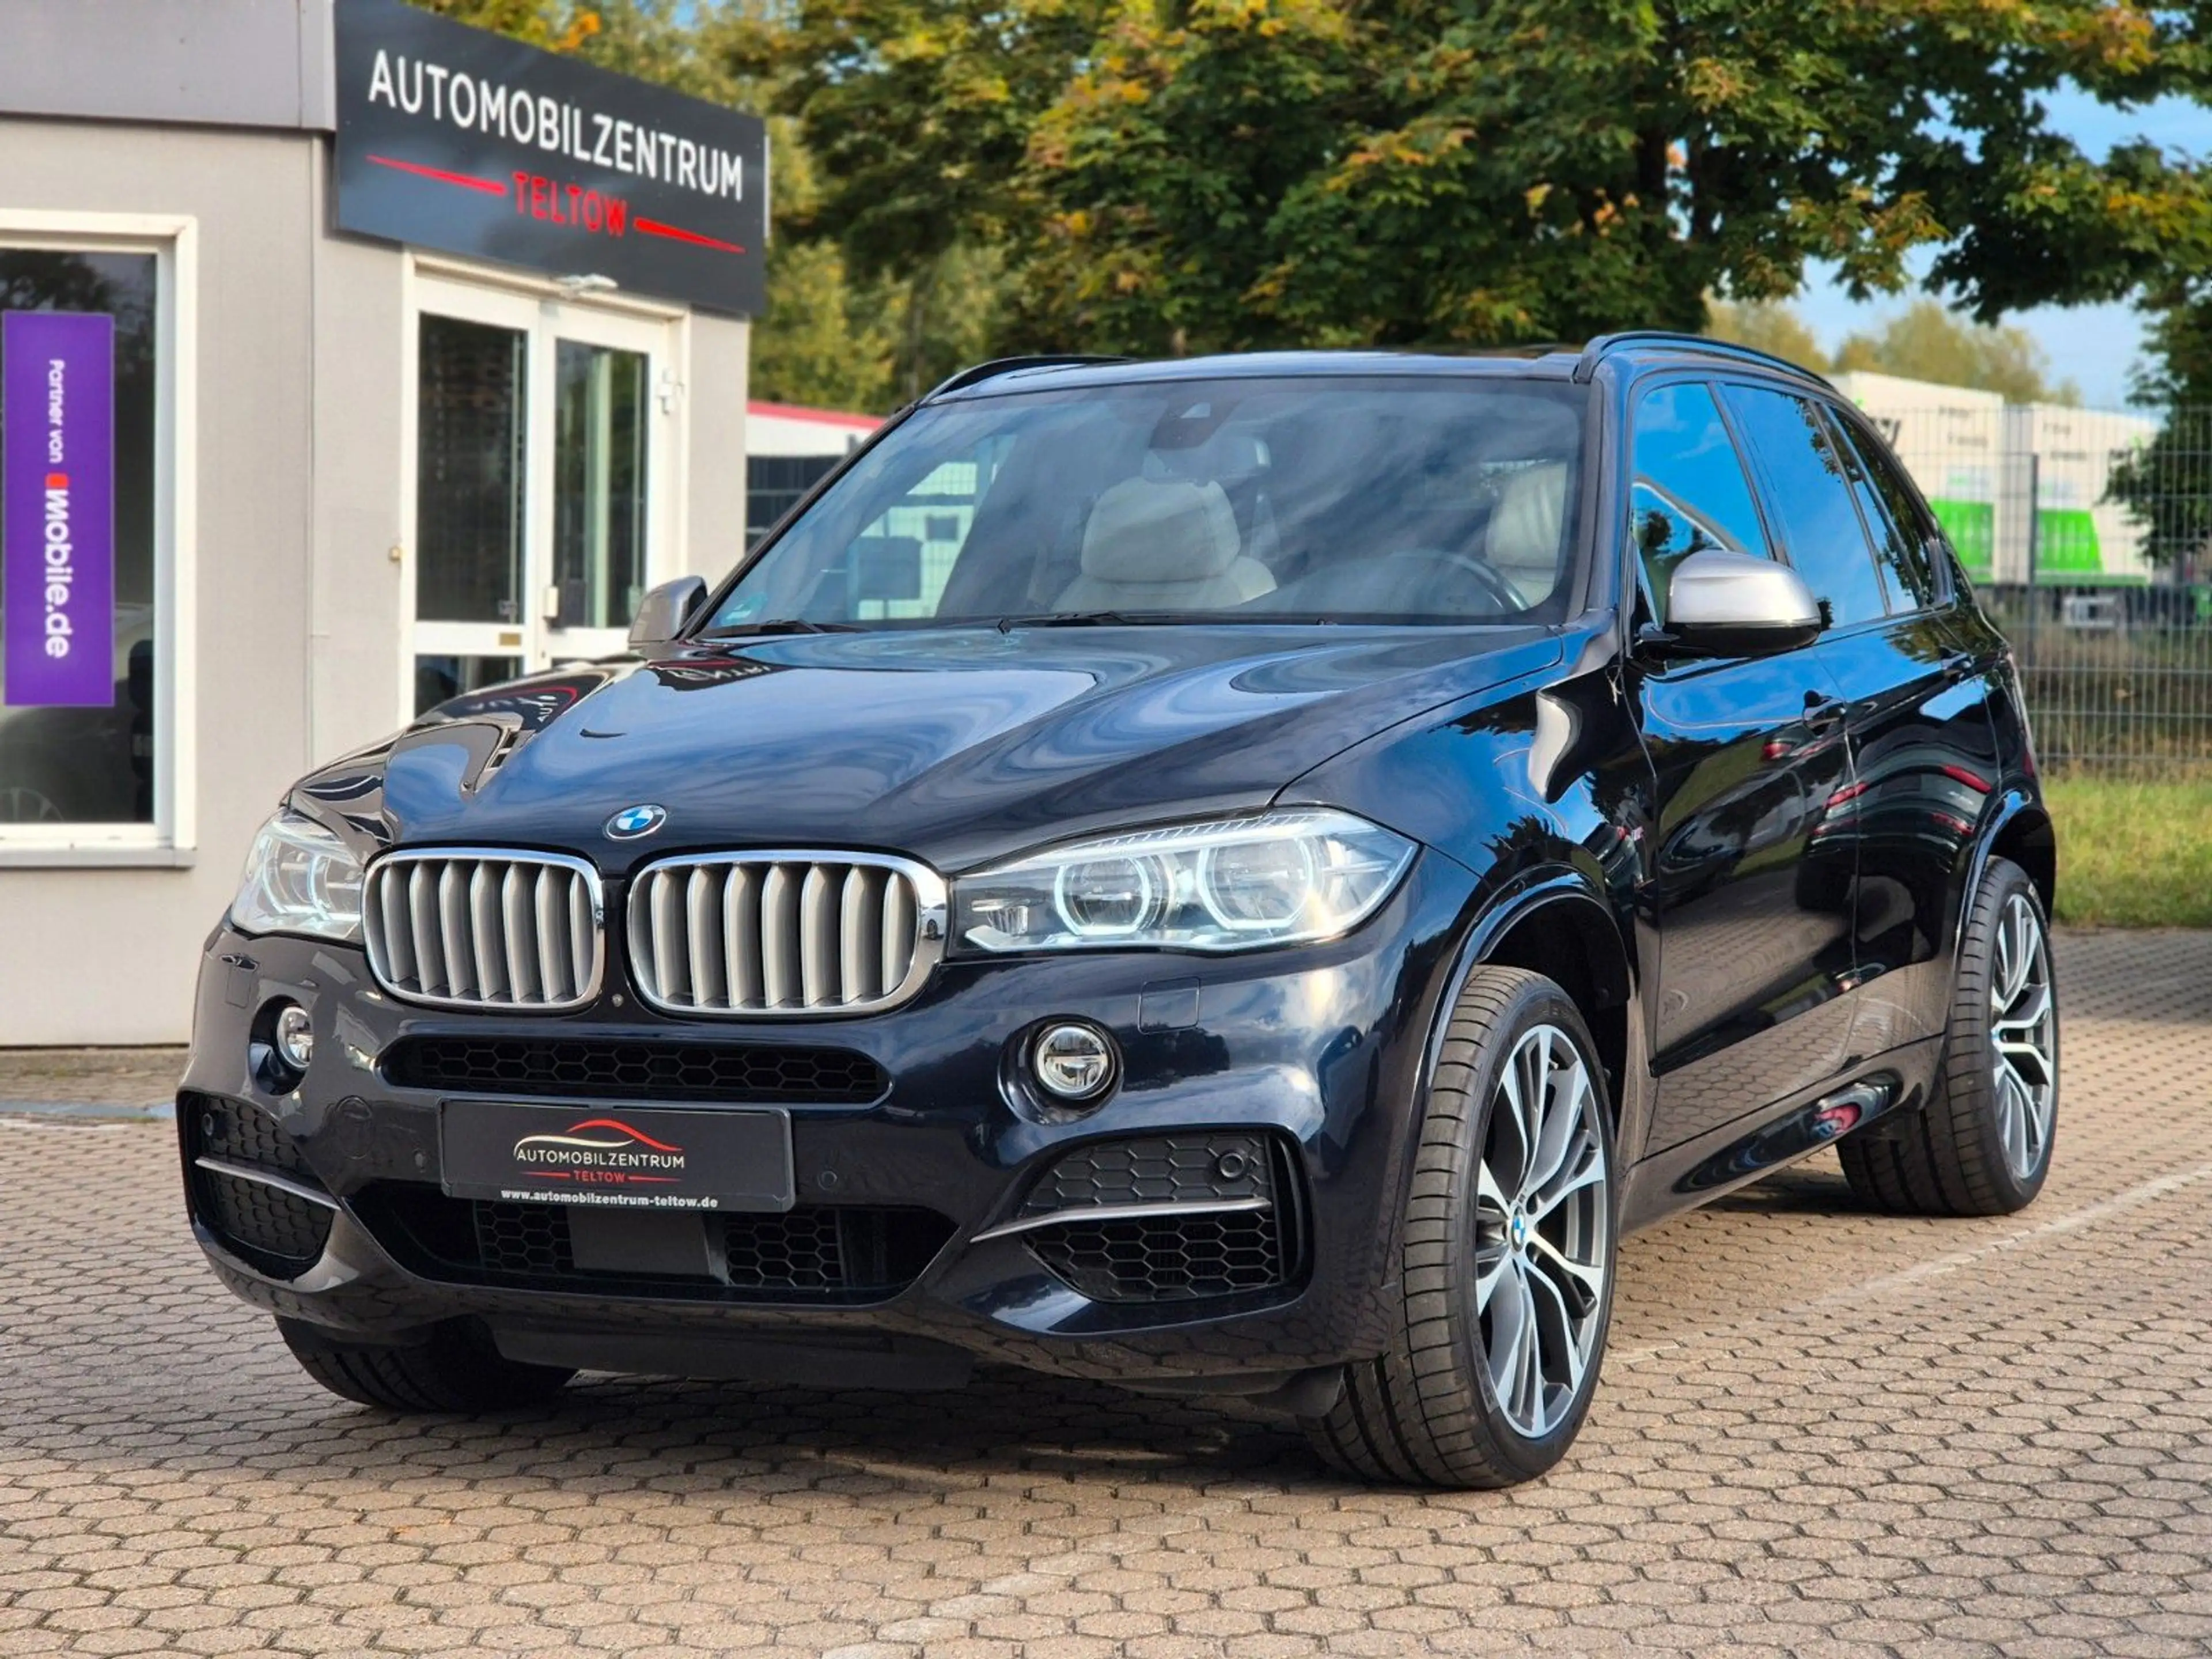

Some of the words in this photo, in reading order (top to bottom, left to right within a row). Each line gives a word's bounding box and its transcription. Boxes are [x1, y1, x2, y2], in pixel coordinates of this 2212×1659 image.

[368, 49, 743, 202] AUTOMOBILZENTRUM
[512, 172, 628, 237] TELTOW
[48, 359, 65, 426] Partner
[48, 429, 63, 463] von
[44, 488, 73, 658] mobile.de
[517, 1149, 685, 1169] AUTOMOBILZENTRUM
[573, 1170, 626, 1184] TELTOW
[501, 1190, 719, 1208] www.automobilzentrum-teltow.de
